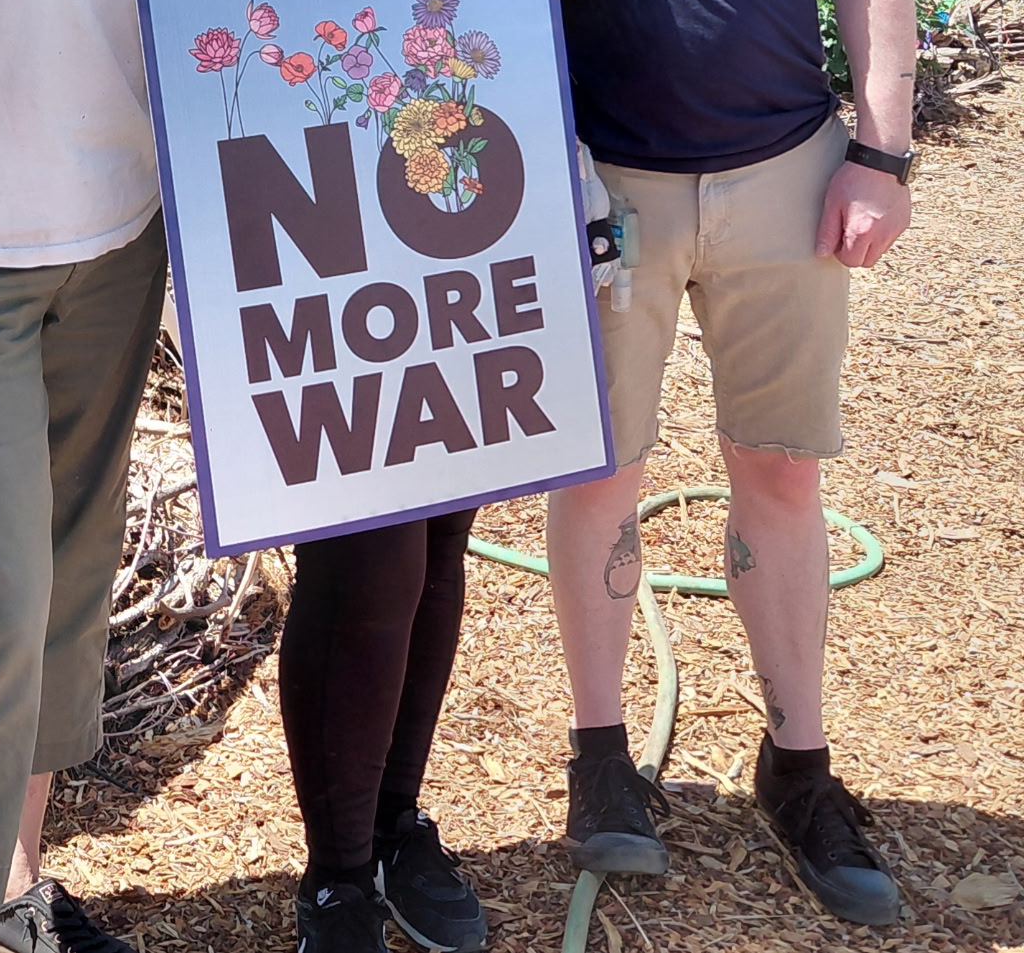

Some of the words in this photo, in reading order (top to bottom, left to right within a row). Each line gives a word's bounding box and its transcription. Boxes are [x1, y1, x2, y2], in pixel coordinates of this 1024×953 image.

[217, 104, 525, 292] NO
[239, 255, 545, 384] MORE
[251, 345, 556, 486] WAR
